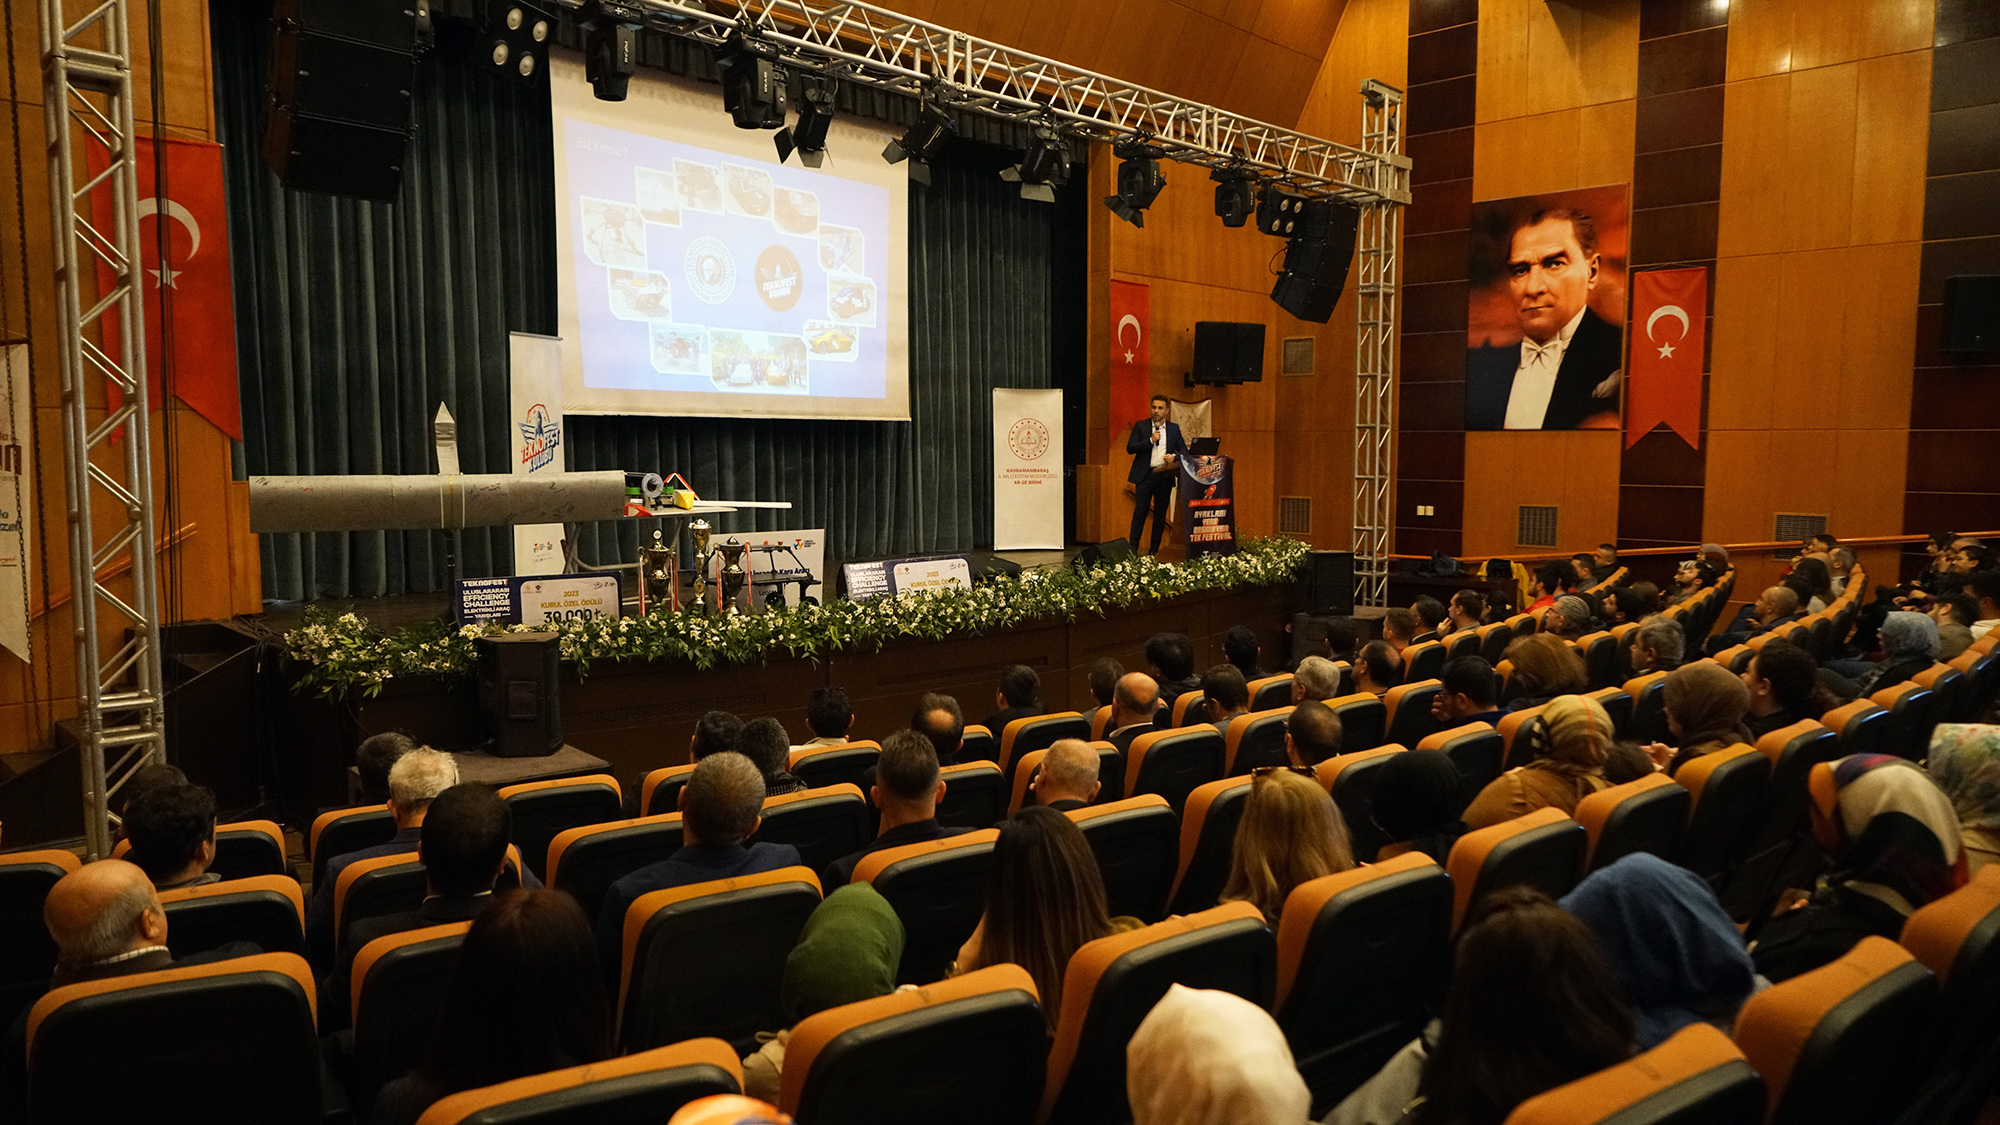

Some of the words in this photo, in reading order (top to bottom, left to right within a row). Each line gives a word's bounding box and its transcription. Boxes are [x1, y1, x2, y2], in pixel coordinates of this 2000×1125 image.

[763, 276, 797, 292] TEKNOFEST
[521, 429, 560, 464] TEKNOFEST
[463, 579, 508, 587] TEKNOFEST
[928, 579, 941, 587] ÖZEL
[463, 593, 510, 601] EFFICIENCY
[563, 590, 579, 598] 2023
[463, 599, 511, 608] CHALLENGE
[581, 598, 603, 607] ÖDÜLÜ
